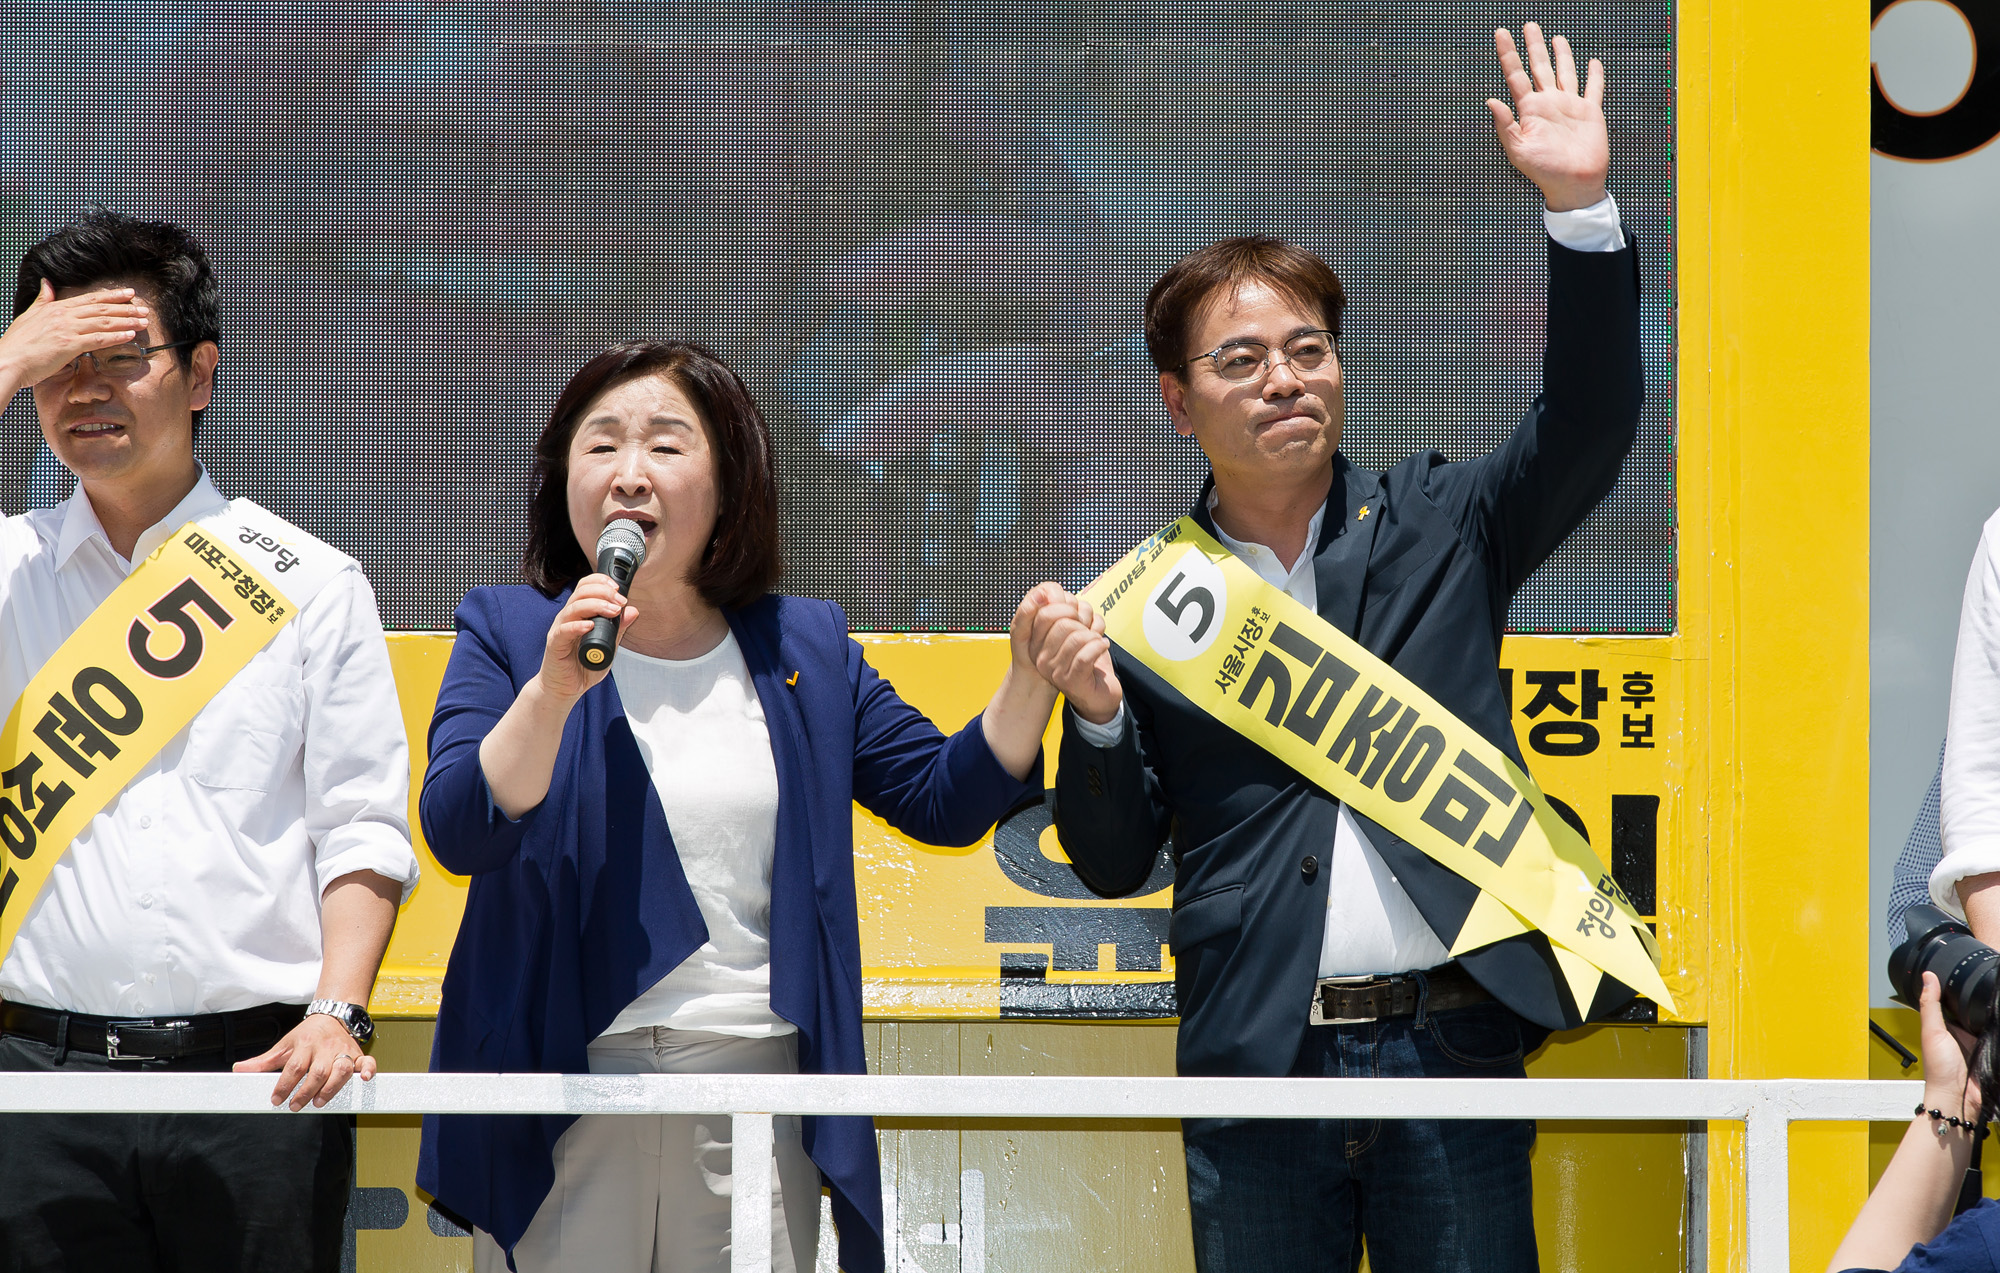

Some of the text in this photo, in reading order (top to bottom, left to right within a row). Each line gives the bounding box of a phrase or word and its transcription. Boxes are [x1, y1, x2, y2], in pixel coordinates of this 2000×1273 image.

[183, 531, 286, 625] 마포구청장 후보
[238, 525, 300, 573] 정의당
[1100, 559, 1147, 616] 제1야당
[1149, 523, 1182, 563] 교체!
[128, 574, 236, 680] 5
[1154, 570, 1216, 645] 5
[1214, 606, 1271, 695] 서울시장 후보
[1237, 621, 1535, 868] 김종민
[1499, 668, 1656, 757] 장 후보
[0, 666, 144, 918] 윤성
[1576, 873, 1630, 939] 정의당
